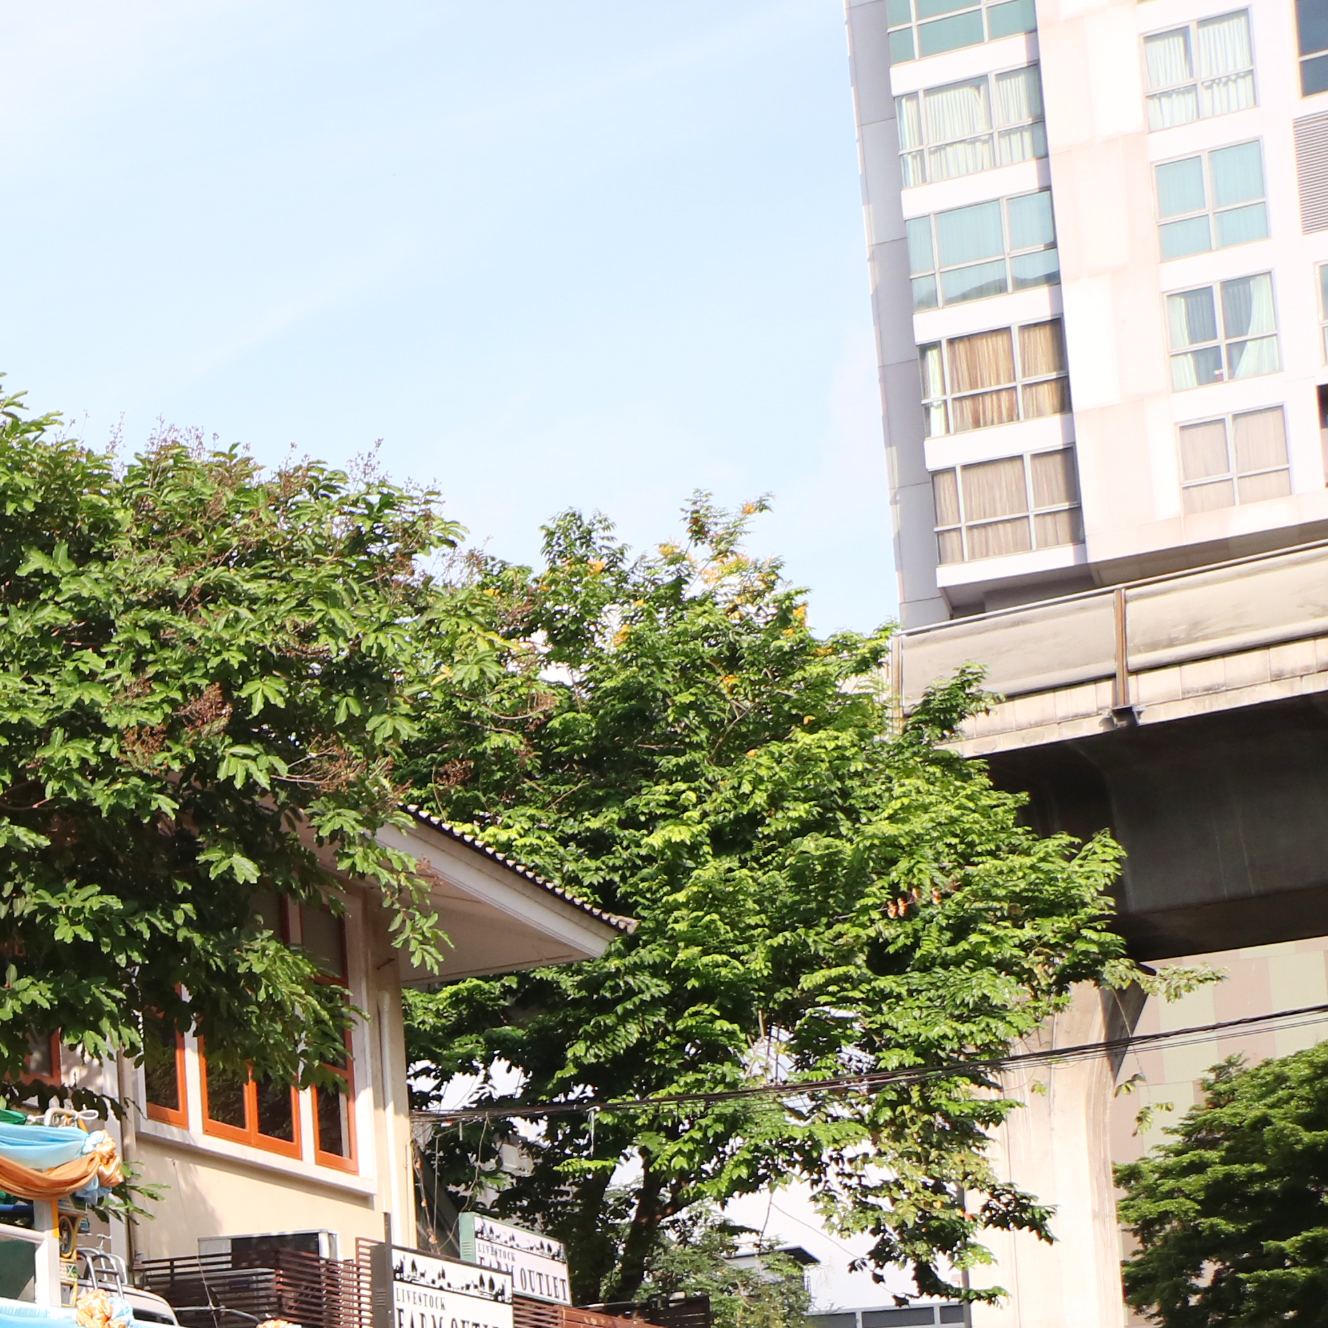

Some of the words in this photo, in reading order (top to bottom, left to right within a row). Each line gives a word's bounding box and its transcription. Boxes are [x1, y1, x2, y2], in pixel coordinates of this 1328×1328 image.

[477, 1242, 516, 1263] LIVESTOCK
[519, 1267, 568, 1302] OUTLET
[395, 1287, 446, 1311] LIVESTOCK
